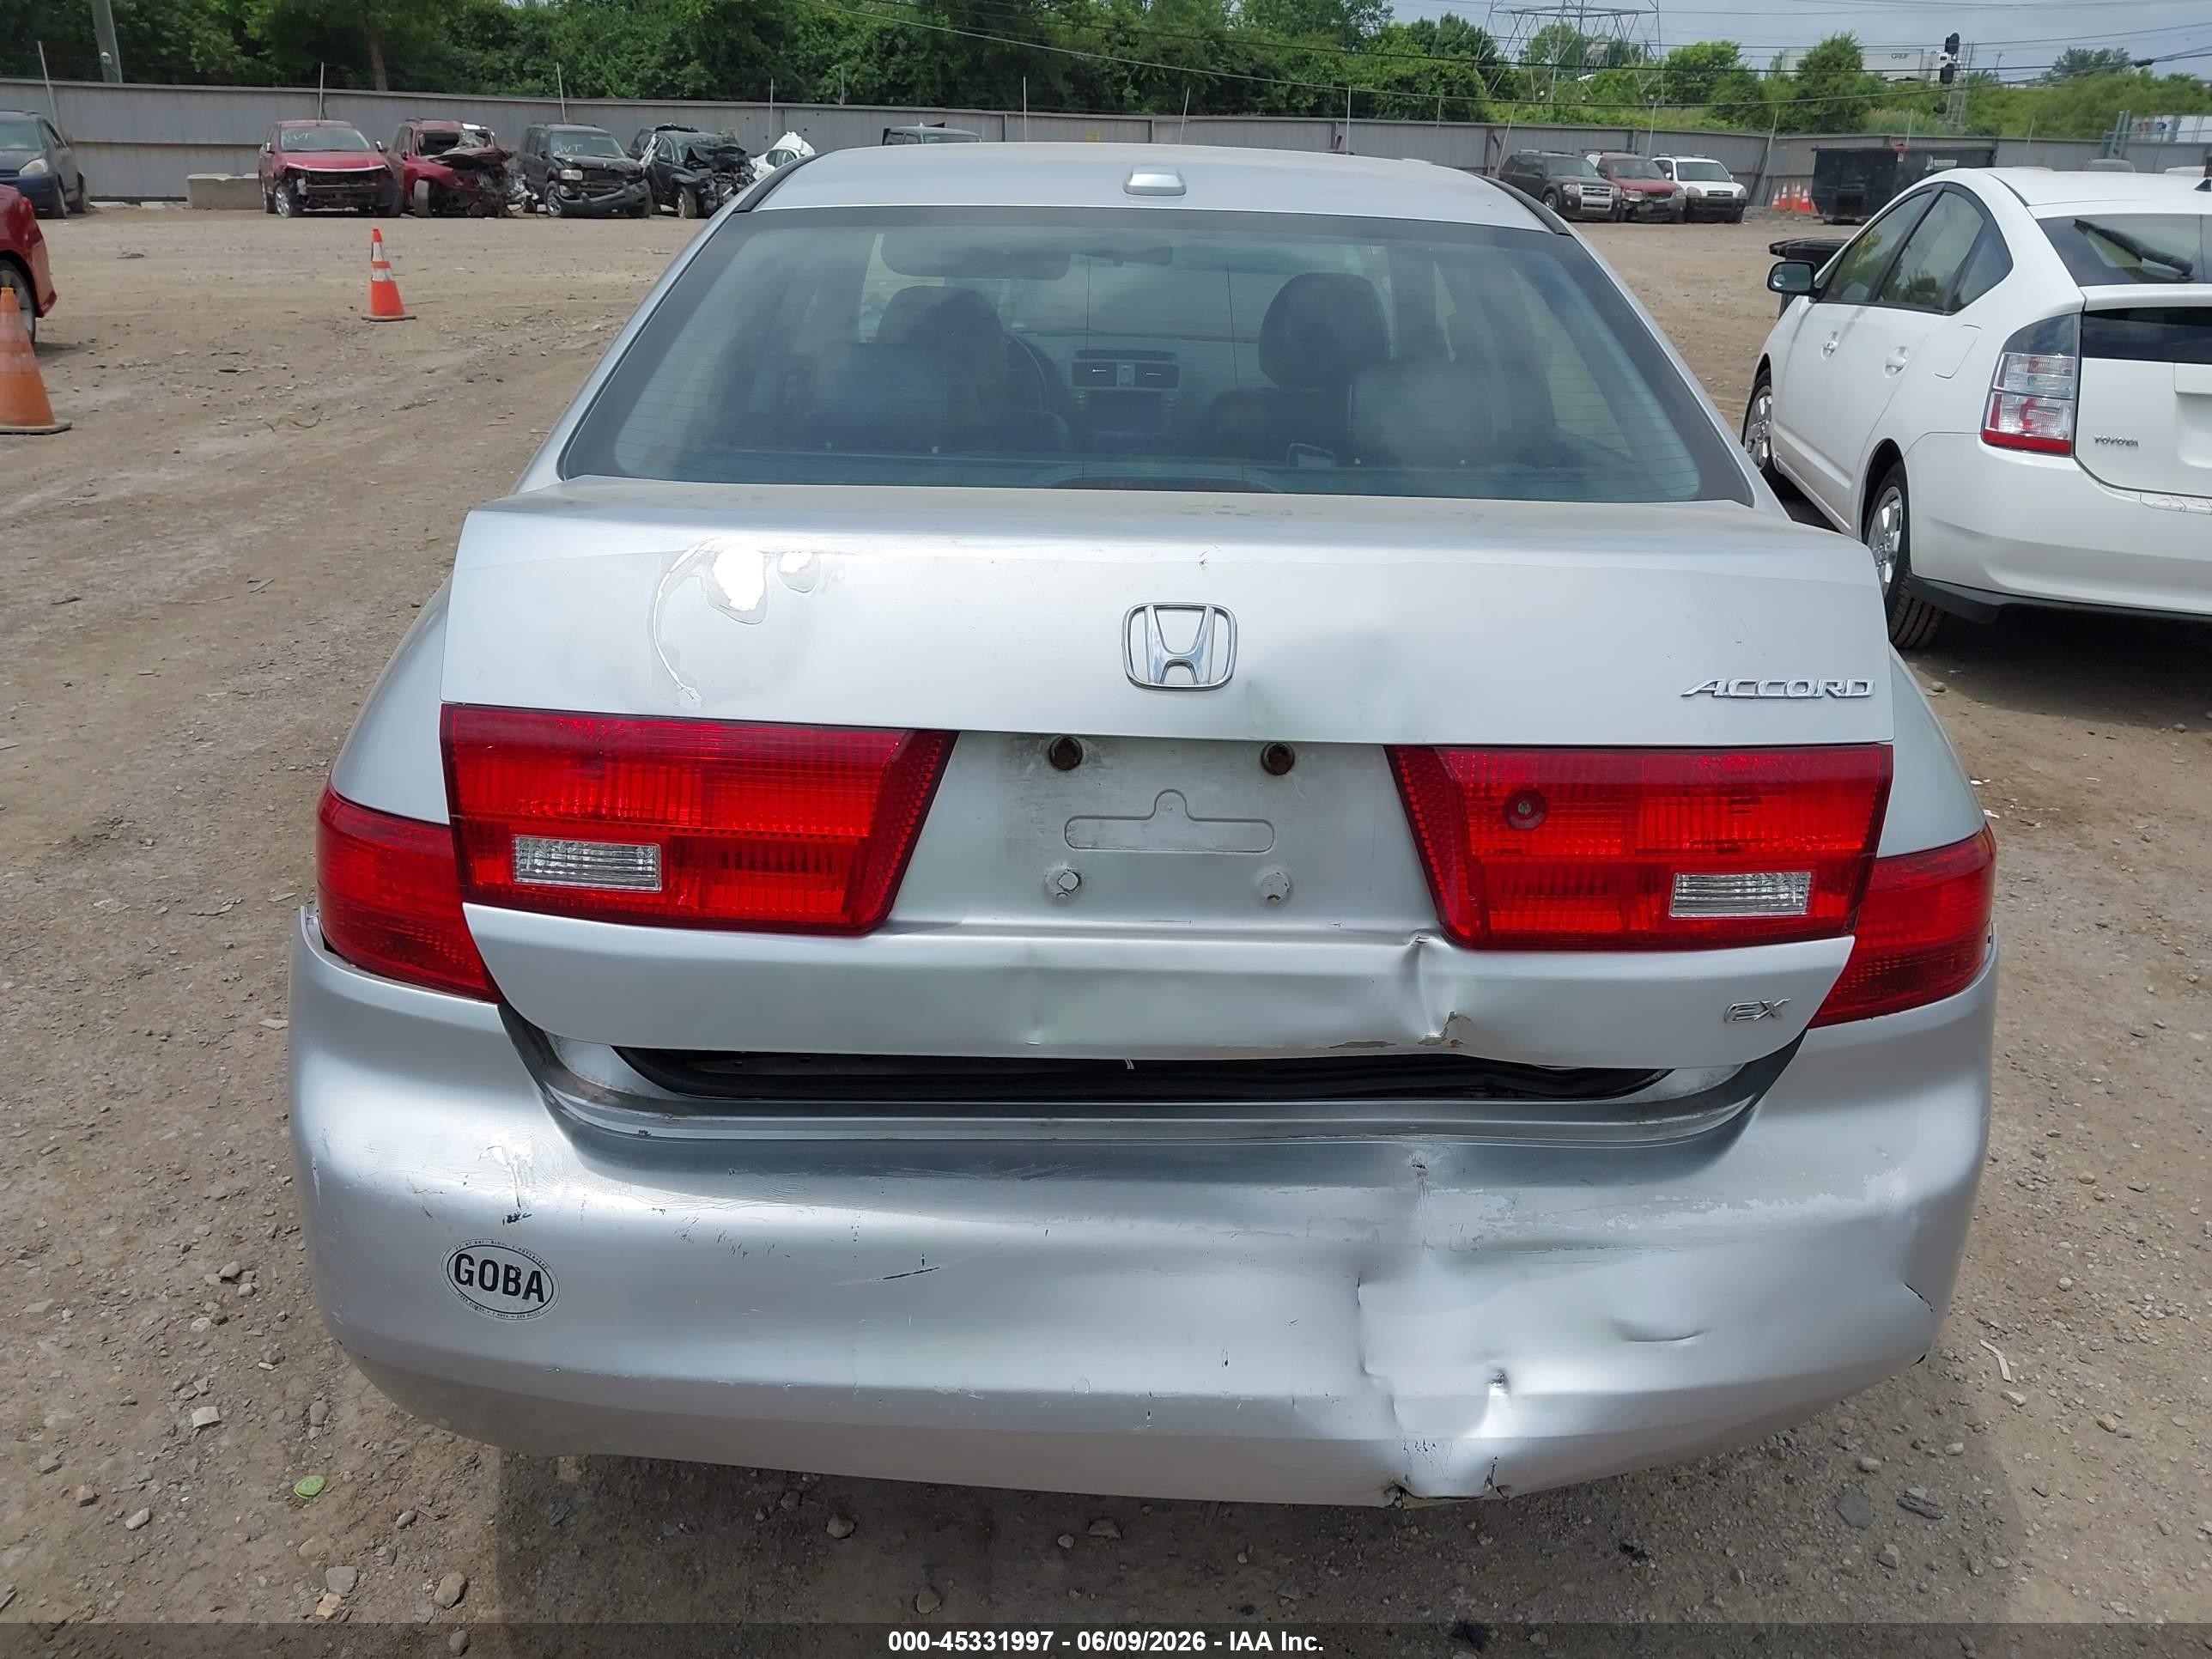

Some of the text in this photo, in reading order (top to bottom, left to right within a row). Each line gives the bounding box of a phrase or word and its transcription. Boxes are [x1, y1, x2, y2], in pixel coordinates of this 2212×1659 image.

[2094, 435, 2139, 447] TOYOTA
[1680, 678, 1875, 699] ACCORD
[1724, 998, 1791, 1024] EX
[453, 1253, 545, 1304] GOBA
